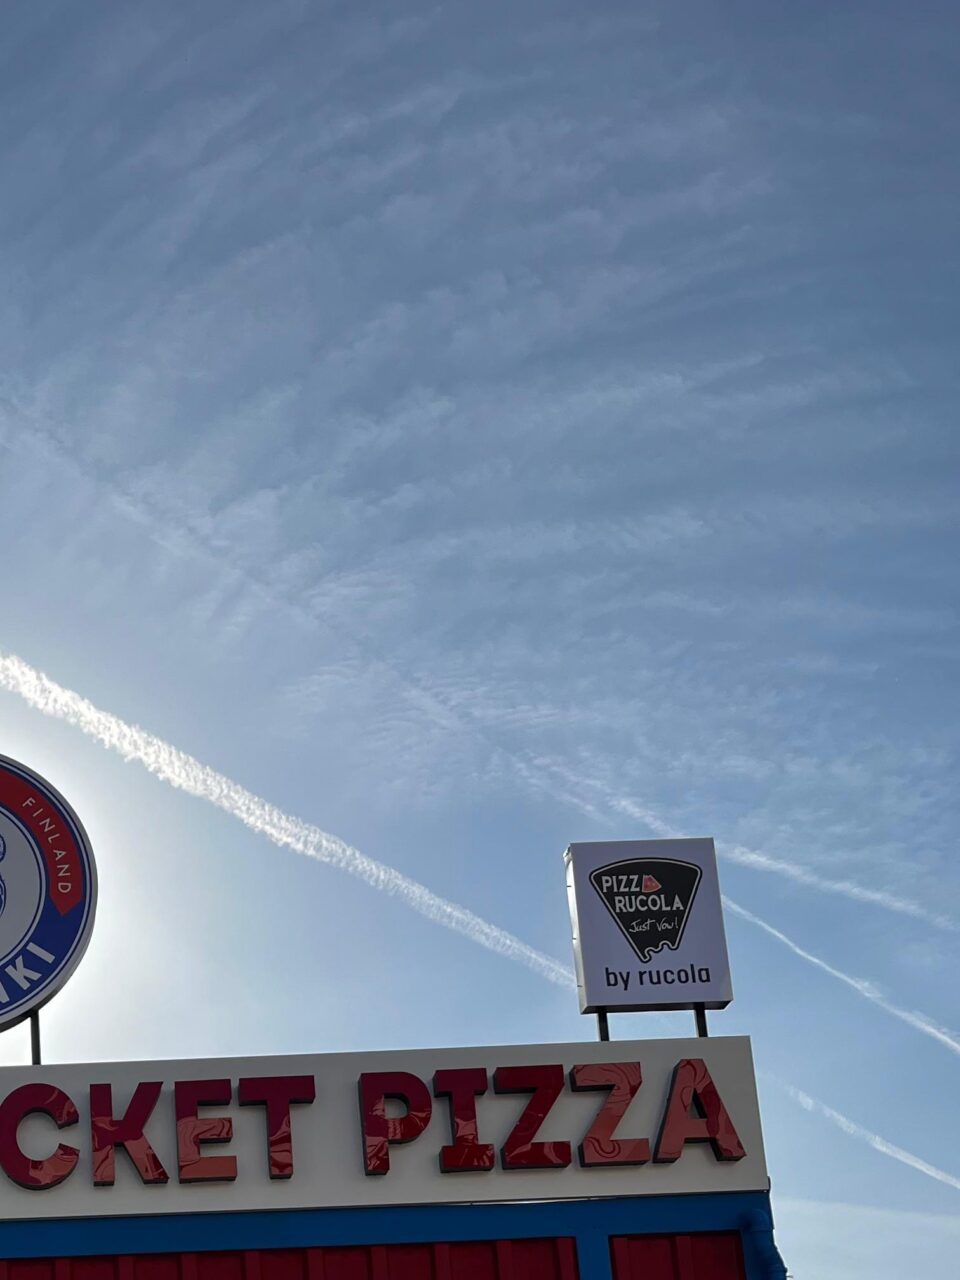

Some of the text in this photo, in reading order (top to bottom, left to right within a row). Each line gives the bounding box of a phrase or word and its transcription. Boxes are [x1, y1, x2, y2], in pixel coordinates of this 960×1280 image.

[22, 797, 72, 894] FINLAND
[614, 894, 684, 913] RUCOLA
[628, 917, 656, 933] Just
[605, 963, 711, 991] by rucola
[357, 1058, 746, 1176] PIZZA
